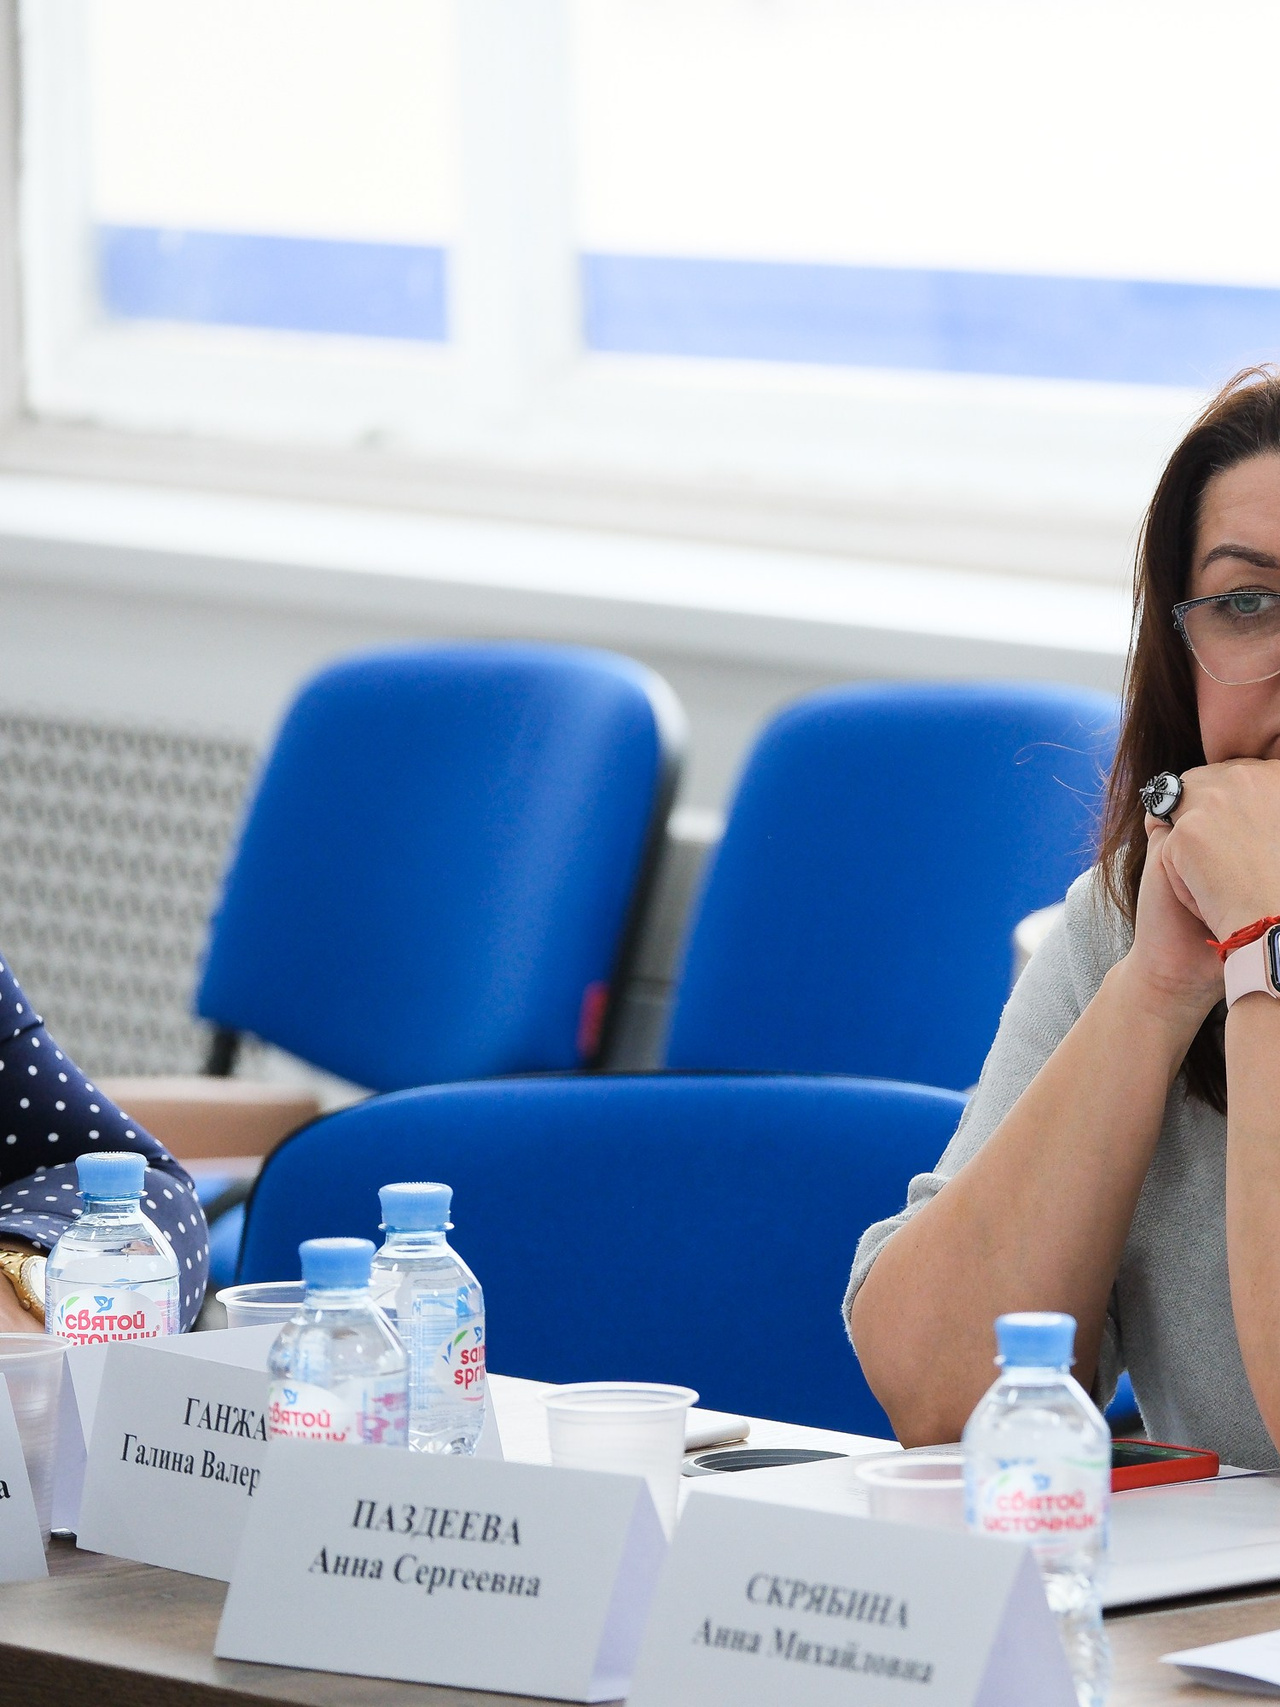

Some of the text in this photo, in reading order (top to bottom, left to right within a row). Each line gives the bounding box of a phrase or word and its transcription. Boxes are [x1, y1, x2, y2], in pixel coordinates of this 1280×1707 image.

[183, 1396, 268, 1442] ГАНЖА
[120, 1432, 195, 1476] Галина
[352, 1499, 521, 1546] ПАЗДЕЕВА
[308, 1545, 541, 1597] Анна Сергеевна
[746, 1571, 908, 1630] СКРЯБИНА
[693, 1616, 935, 1684] Анна Михайловна
